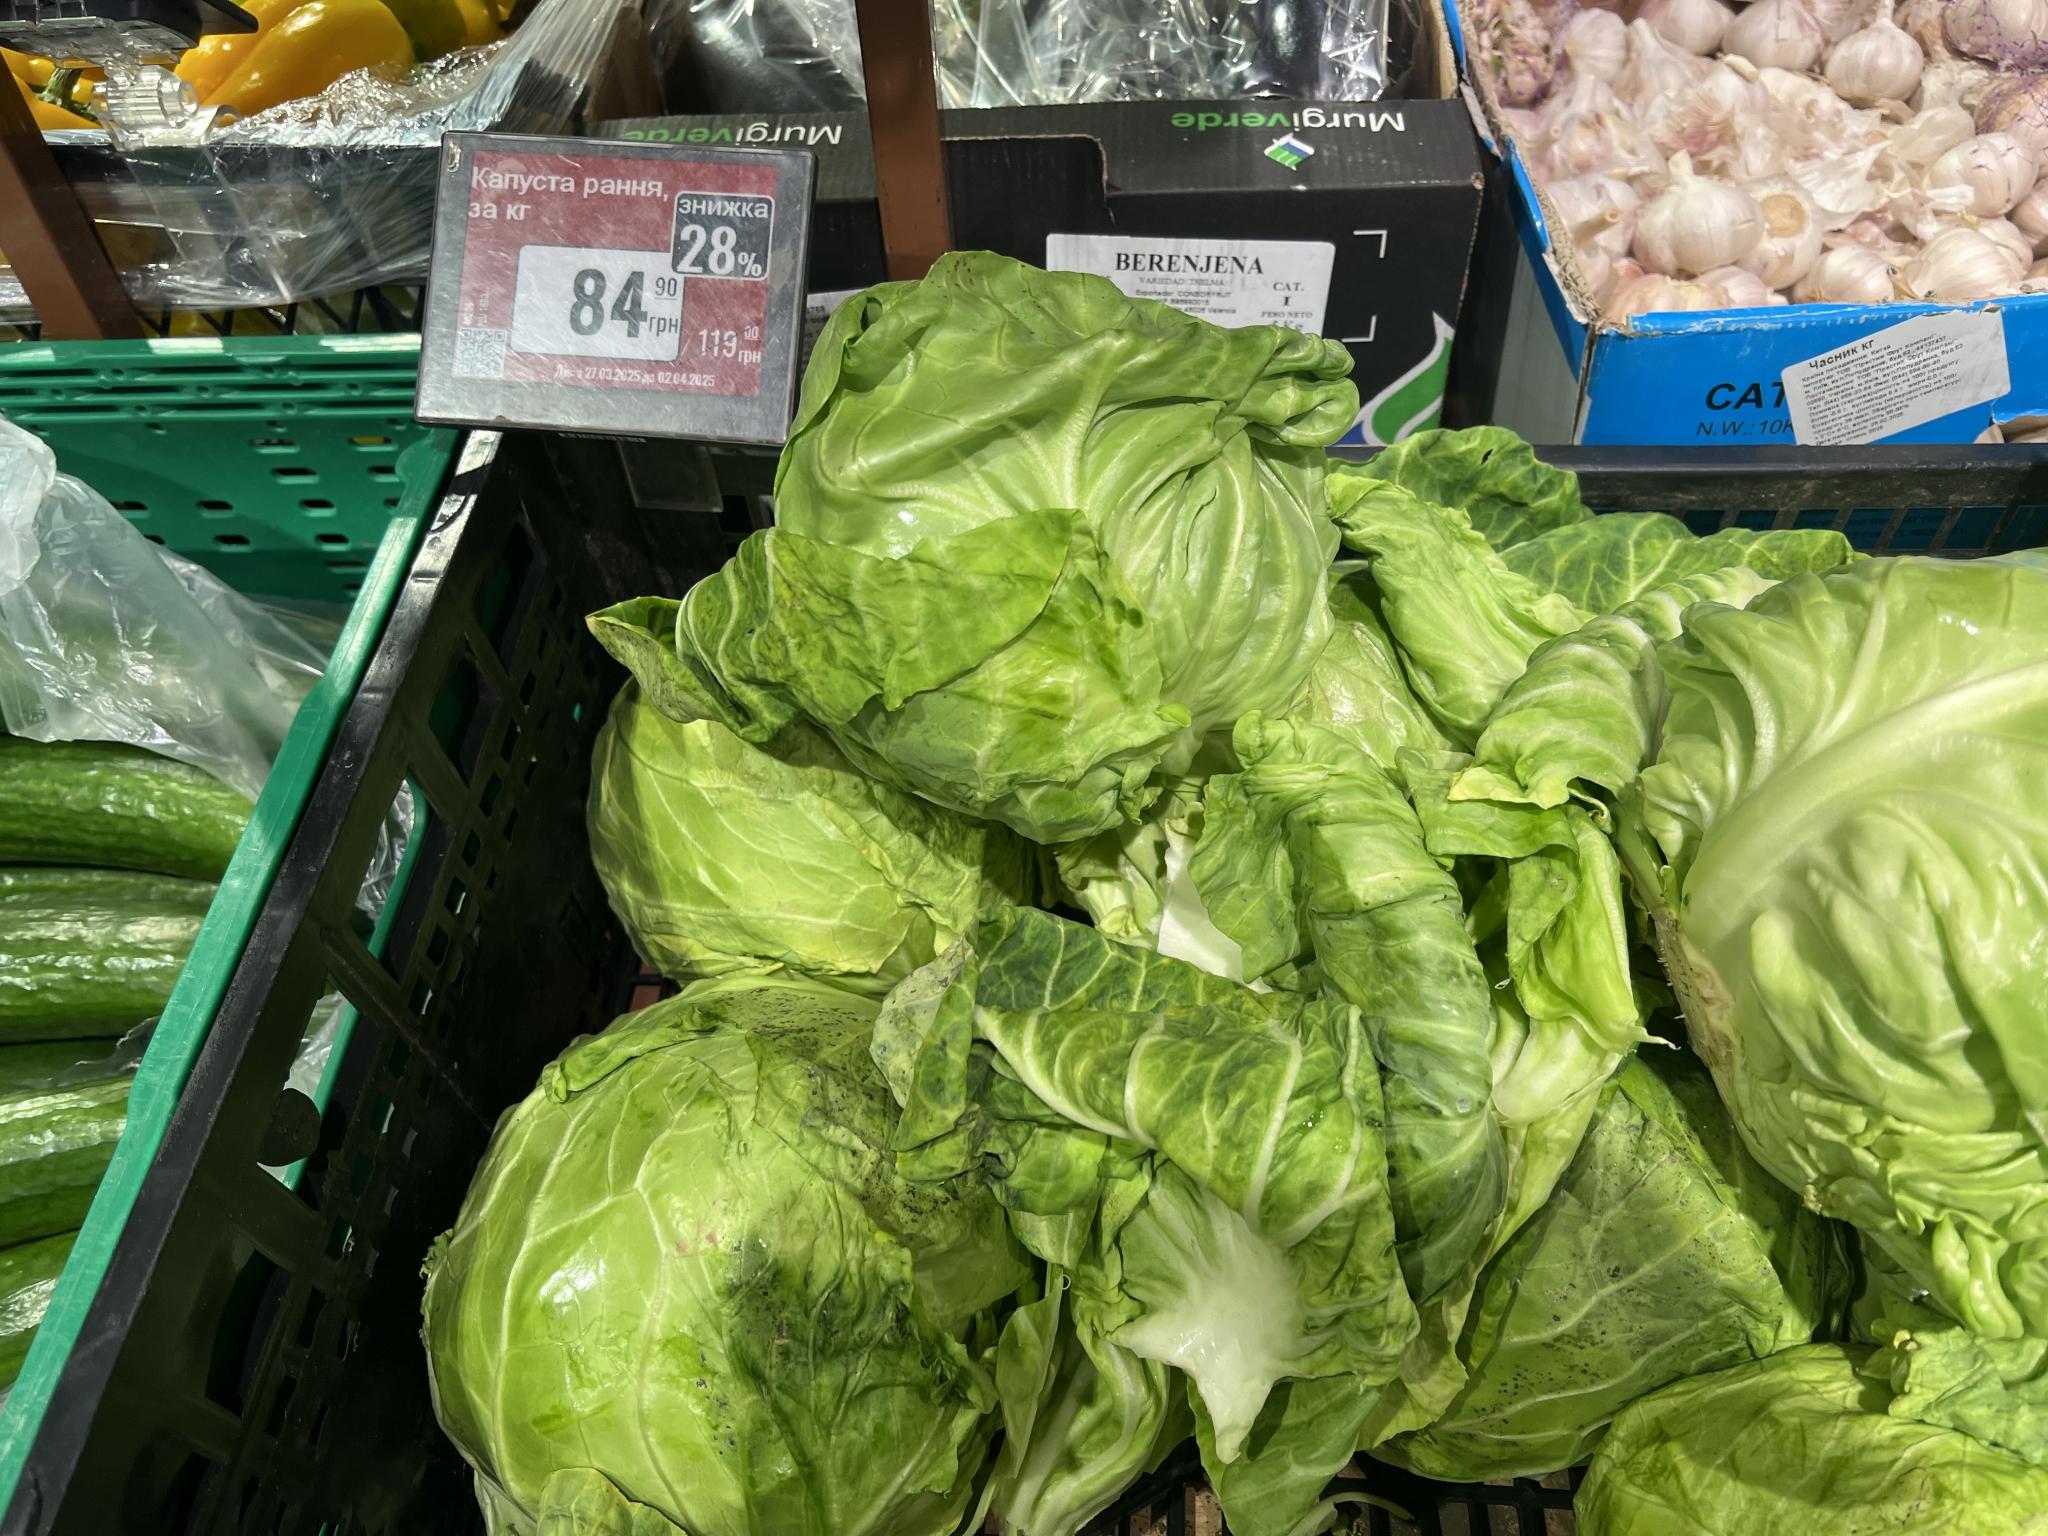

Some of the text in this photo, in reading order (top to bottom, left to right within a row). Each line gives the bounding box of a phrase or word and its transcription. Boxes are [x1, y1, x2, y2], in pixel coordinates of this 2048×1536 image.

[1171, 107, 1405, 132] Murgiverde
[471, 167, 668, 201] Капуста рання,
[468, 204, 531, 221] за кг
[679, 199, 769, 218] знижка
[677, 224, 763, 276] 28%
[1116, 252, 1263, 274] BERENJENA
[1273, 281, 1304, 291] CAT.
[569, 268, 677, 338] 84 90
[648, 315, 678, 336] грн
[699, 328, 737, 358] 119
[1809, 338, 1874, 371] Часник кг
[738, 350, 762, 366] грн
